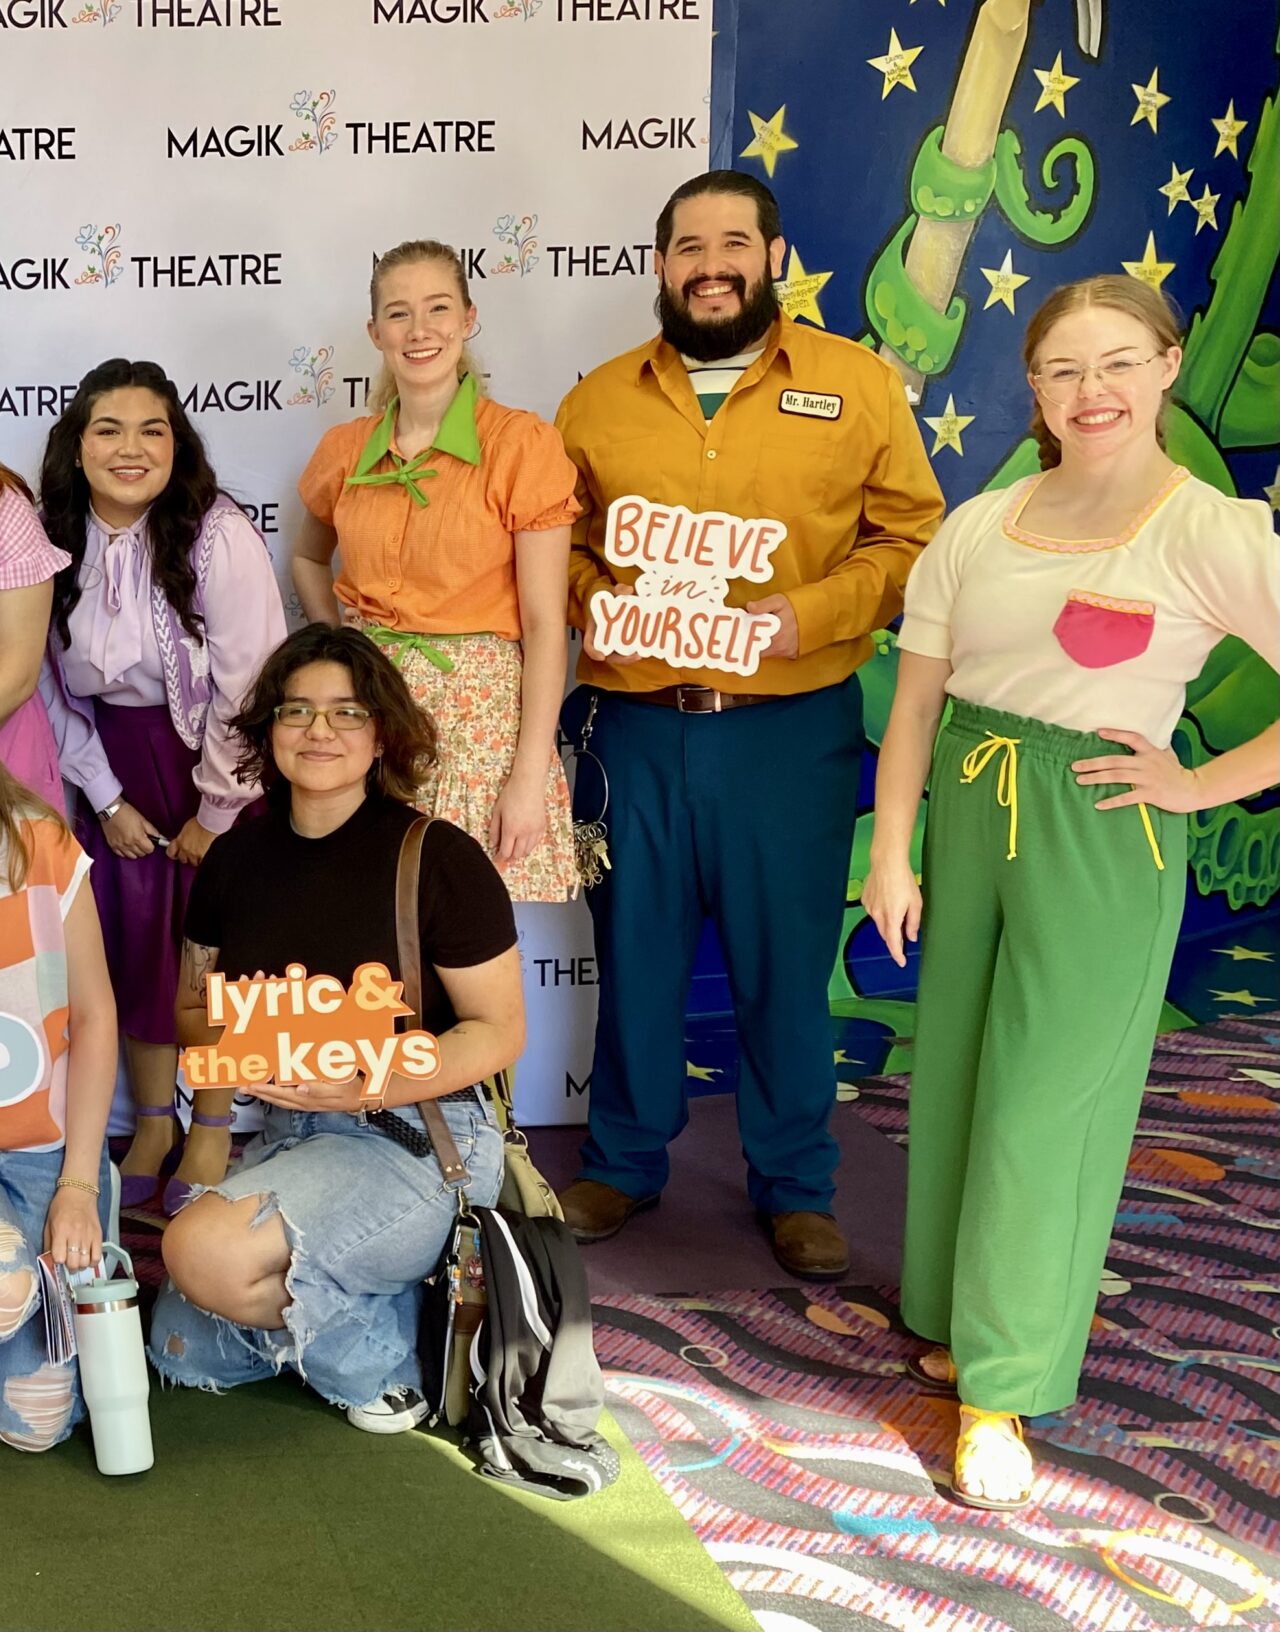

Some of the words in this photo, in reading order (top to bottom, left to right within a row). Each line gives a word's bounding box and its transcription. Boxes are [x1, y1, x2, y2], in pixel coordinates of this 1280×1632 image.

[137, 0, 281, 27] THEATRE
[374, 0, 489, 23] MAGIK
[167, 125, 284, 158] MAGIK
[345, 121, 496, 154] THEATRE
[582, 118, 696, 150] MAGIK
[130, 254, 282, 288] THEATRE
[546, 245, 658, 277] THEAT
[785, 394, 799, 406] Mr.
[802, 396, 838, 414] Hartley
[614, 502, 778, 574] BELIEVE
[660, 577, 708, 600] in
[600, 598, 772, 667] YOURSELF
[210, 966, 343, 1035] lyric
[354, 966, 406, 1012] &
[186, 1048, 269, 1084] the
[277, 1032, 439, 1096] keys
